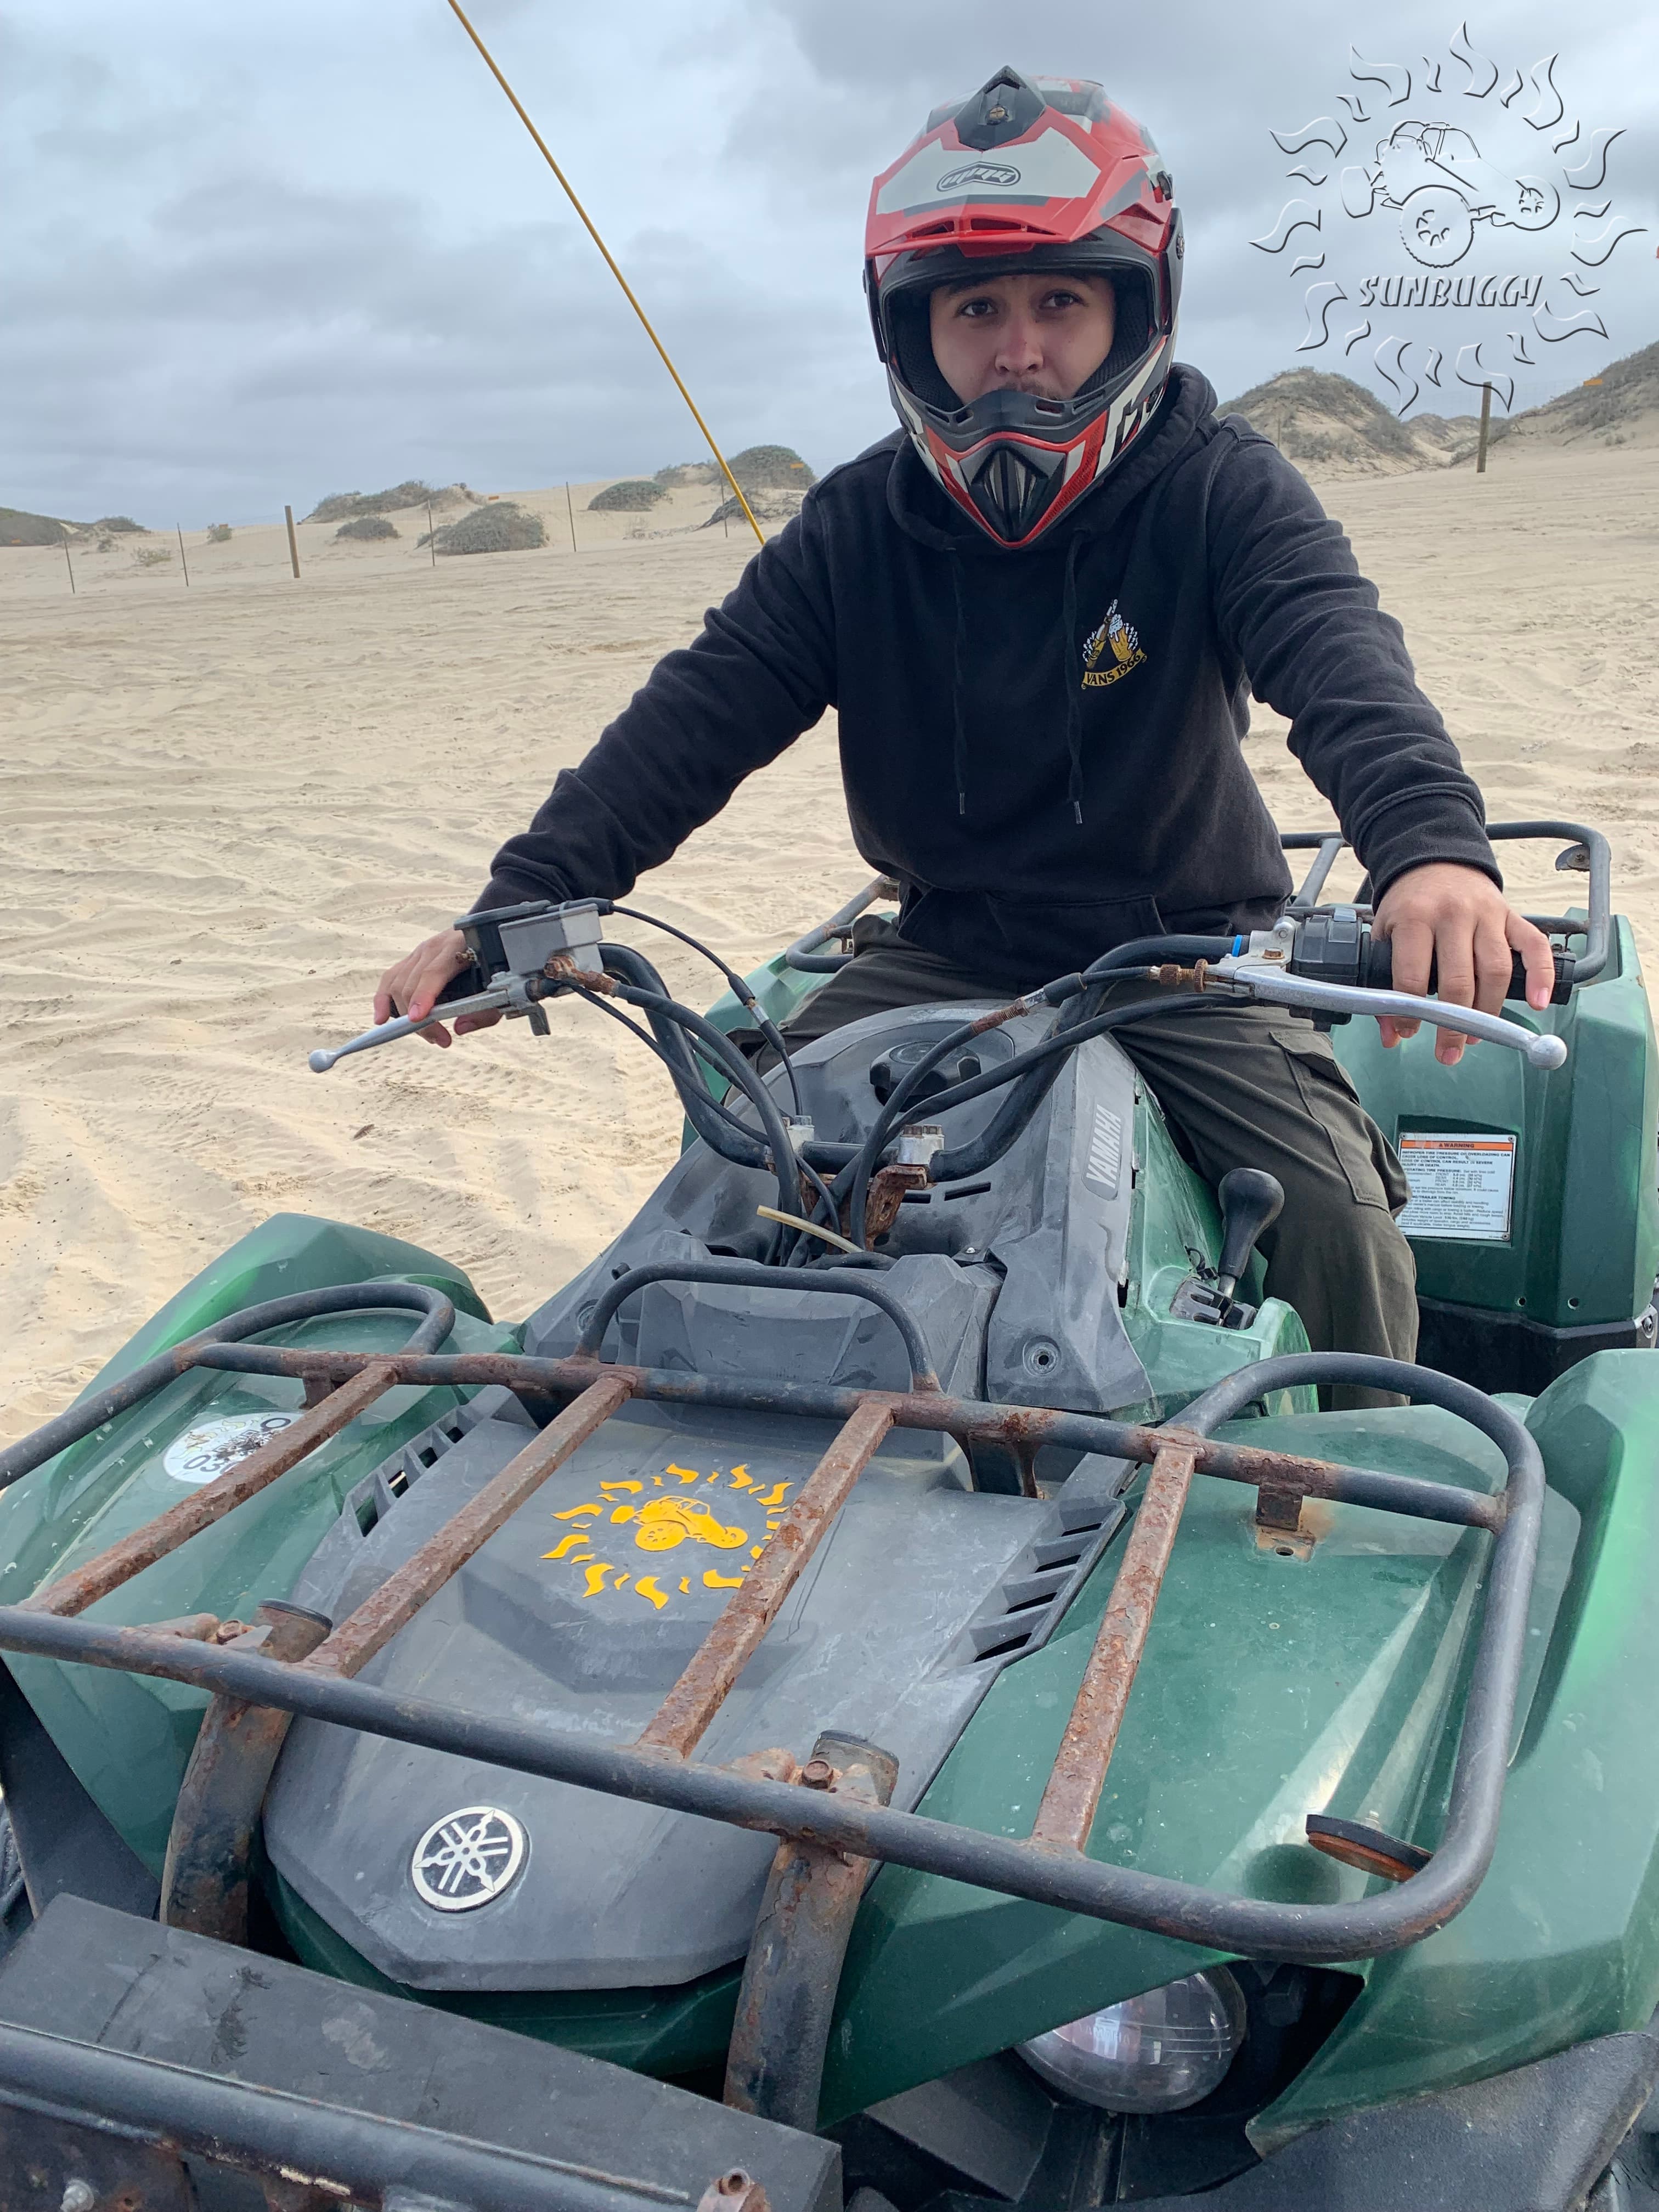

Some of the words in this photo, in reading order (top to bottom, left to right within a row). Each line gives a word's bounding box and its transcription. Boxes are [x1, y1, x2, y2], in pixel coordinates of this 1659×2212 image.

[1087, 672, 1115, 685] VANS
[1117, 653, 1141, 676] 1966
[1086, 1104, 1121, 1188] YAMAHA
